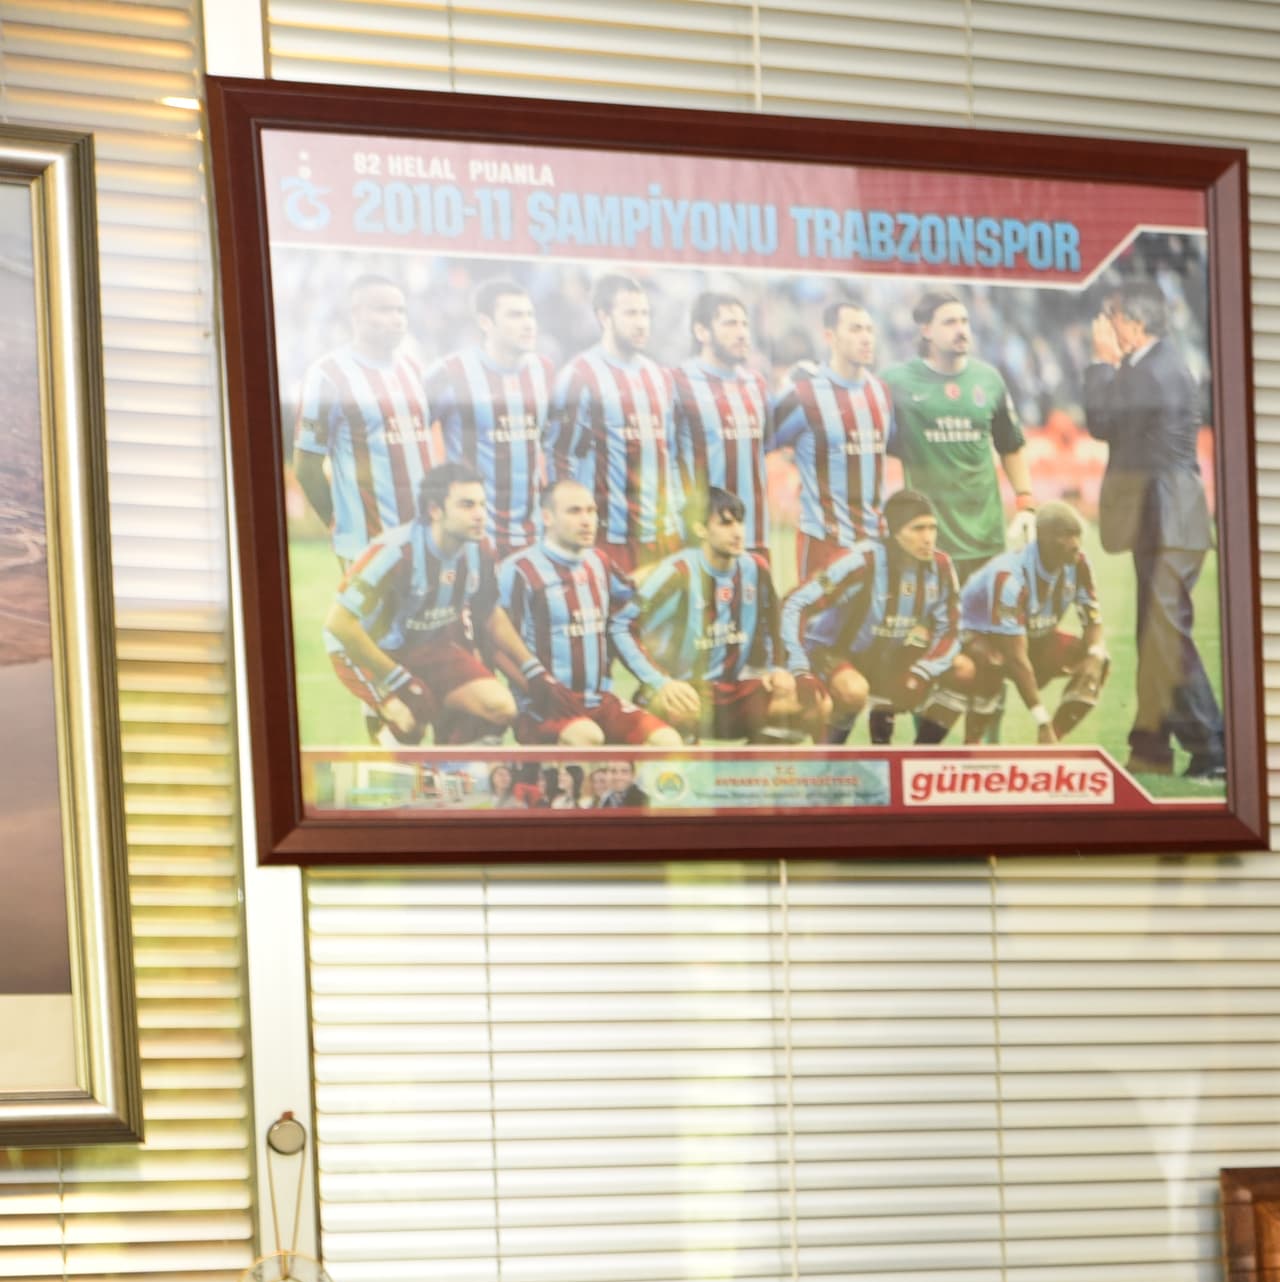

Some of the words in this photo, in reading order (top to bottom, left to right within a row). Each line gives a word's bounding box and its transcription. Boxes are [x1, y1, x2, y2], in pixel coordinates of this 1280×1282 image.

[353, 153, 380, 176] 82
[387, 155, 455, 181] HELAL
[469, 160, 555, 186] PUANLA
[352, 181, 513, 241] 2010-11
[527, 182, 779, 257] ŞAMPİYONU
[789, 205, 1082, 272] TRABZONSPOR
[910, 764, 1109, 801] günebakış
